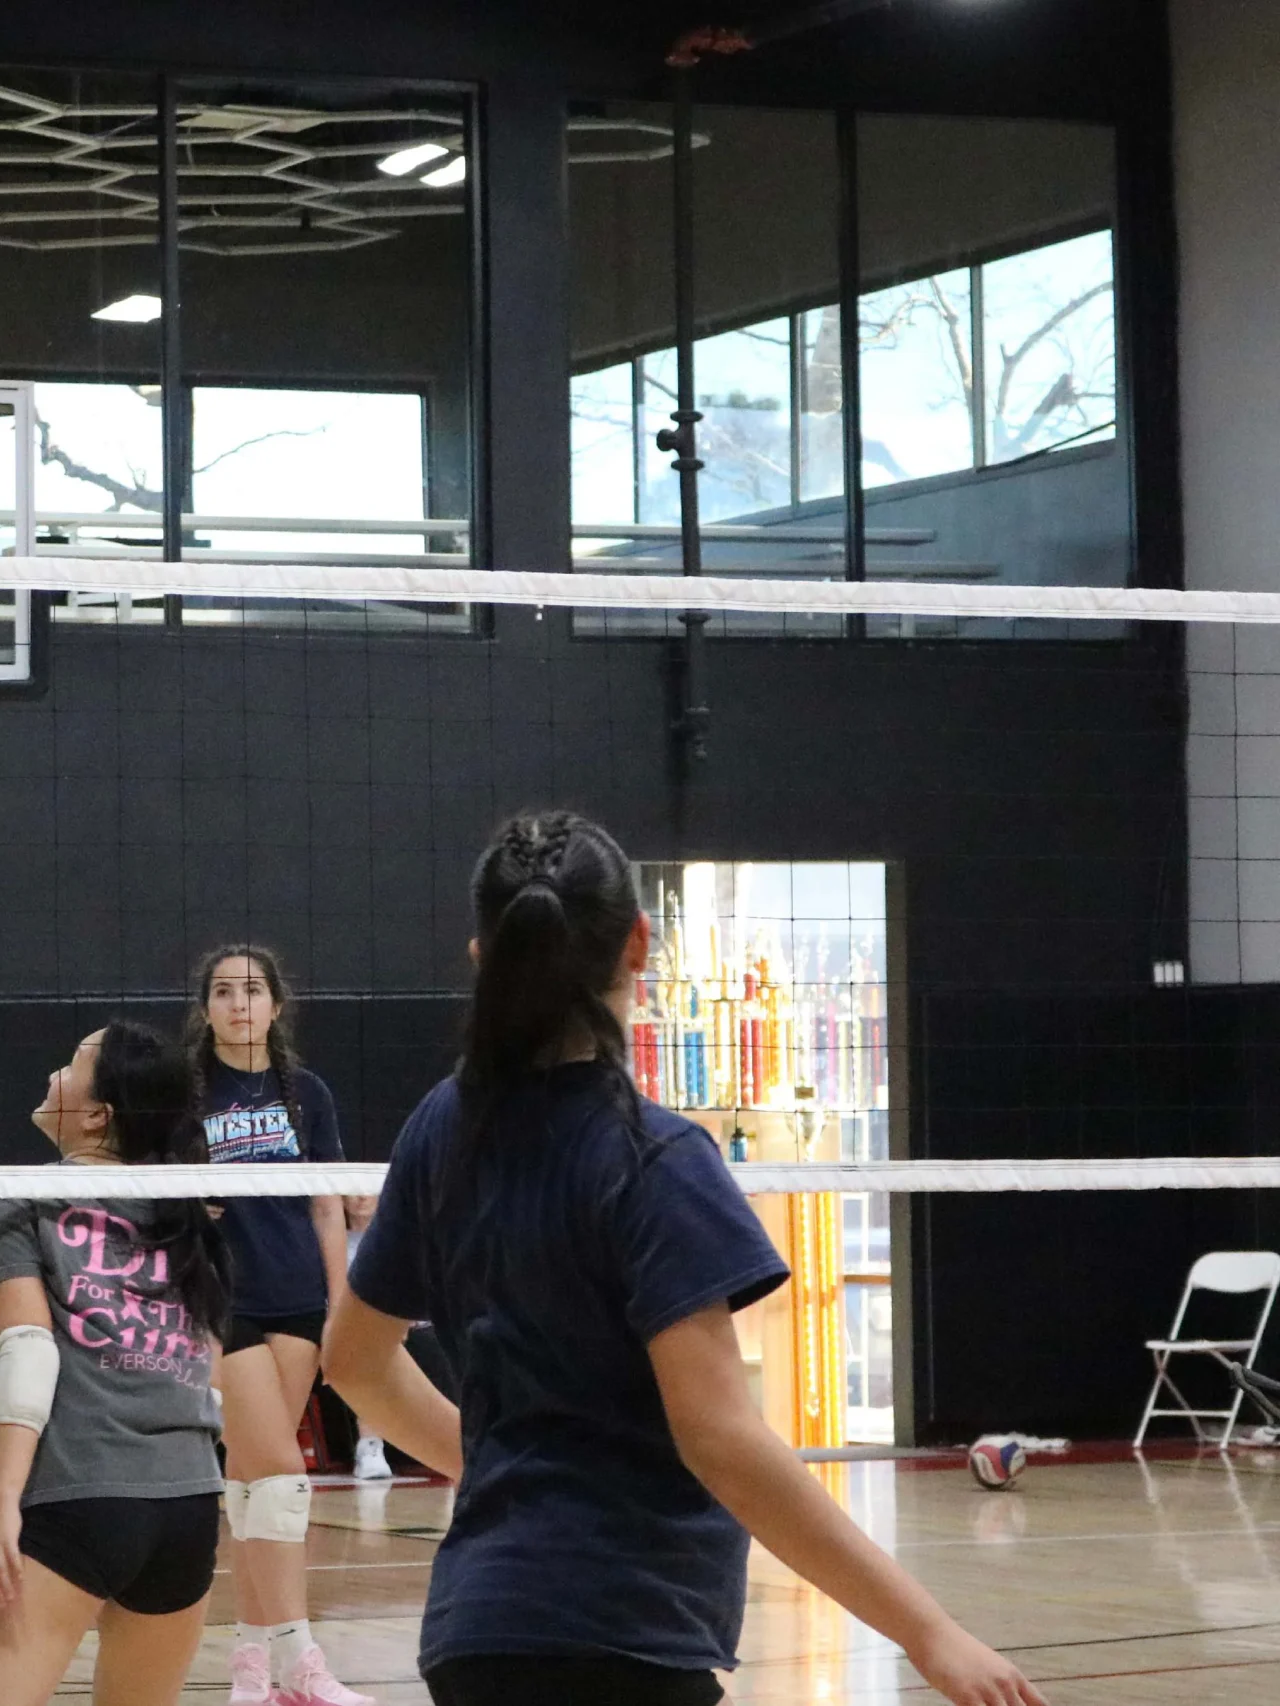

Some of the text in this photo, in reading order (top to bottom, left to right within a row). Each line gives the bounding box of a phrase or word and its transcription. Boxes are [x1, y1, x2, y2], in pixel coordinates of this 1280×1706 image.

[203, 1105, 288, 1147] WESTER
[58, 1207, 169, 1283] Di
[68, 1275, 193, 1331] For Th
